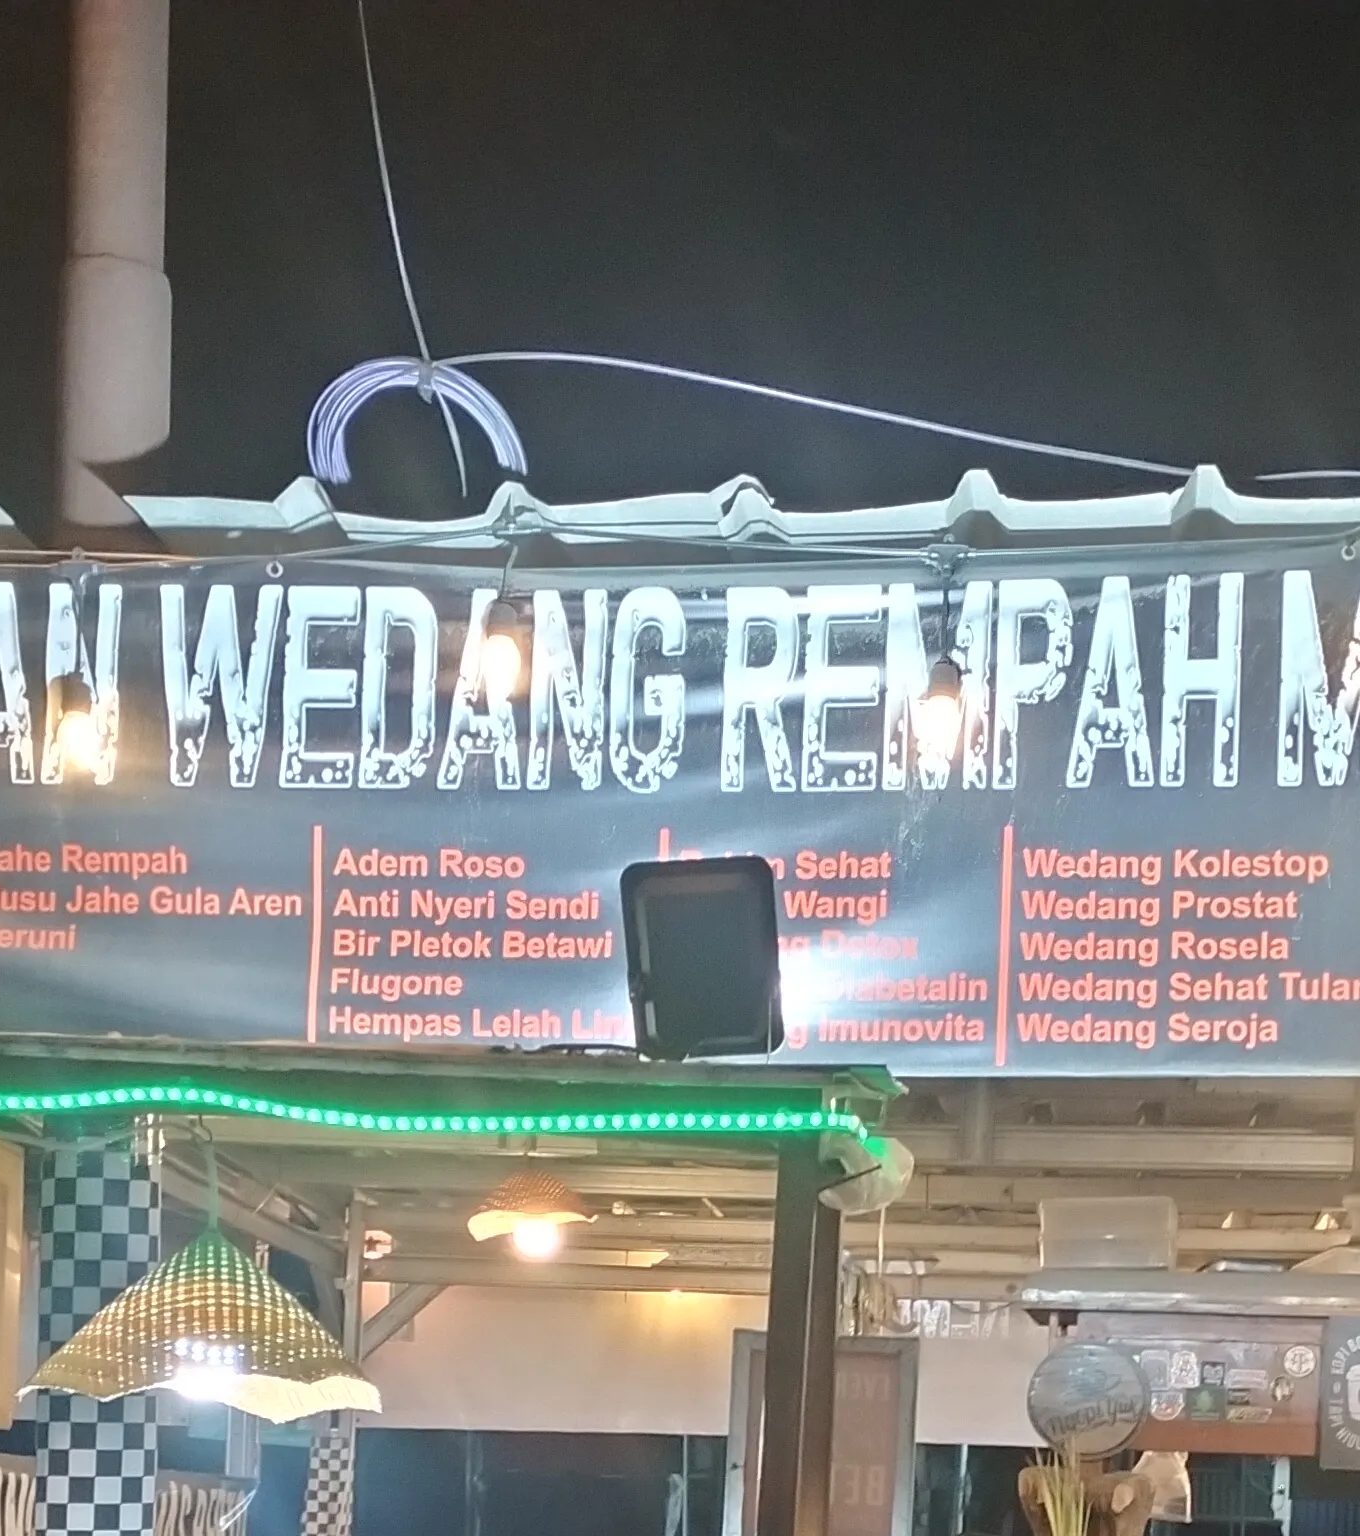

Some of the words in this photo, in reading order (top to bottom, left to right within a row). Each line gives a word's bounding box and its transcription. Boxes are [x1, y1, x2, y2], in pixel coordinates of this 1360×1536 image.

[159, 583, 687, 793] WEDANG
[721, 568, 1244, 793] REMPAH
[61, 844, 188, 880] Rempah
[333, 848, 428, 877] Adem
[440, 848, 525, 879] Roso
[795, 850, 892, 879] Sehat
[1023, 848, 1162, 886] Wedang
[1173, 848, 1329, 884] Kolestop
[65, 884, 139, 914] Jahe
[150, 885, 220, 916] Gula
[228, 887, 302, 917] Aren
[332, 889, 399, 918] Anti
[411, 889, 495, 925] Nyeri
[506, 890, 600, 921] Sendi
[784, 889, 888, 925] Wangi
[1021, 889, 1160, 926] Wedang
[1172, 889, 1298, 920] Prostat
[333, 929, 381, 957] Bir
[390, 929, 492, 958] Pletok
[502, 930, 613, 959] Betawi
[1020, 931, 1159, 967] Wedang
[1170, 930, 1289, 960] Rosela
[330, 968, 463, 1002] Flugone
[1018, 971, 1157, 1008] Wedang
[1169, 971, 1268, 1001] Sehat
[329, 1006, 462, 1043] Hempas
[472, 1008, 561, 1039] Lelah
[818, 1012, 985, 1043] Imunovita
[1017, 1012, 1156, 1050] Wedang
[1167, 1011, 1278, 1049] Seroja
